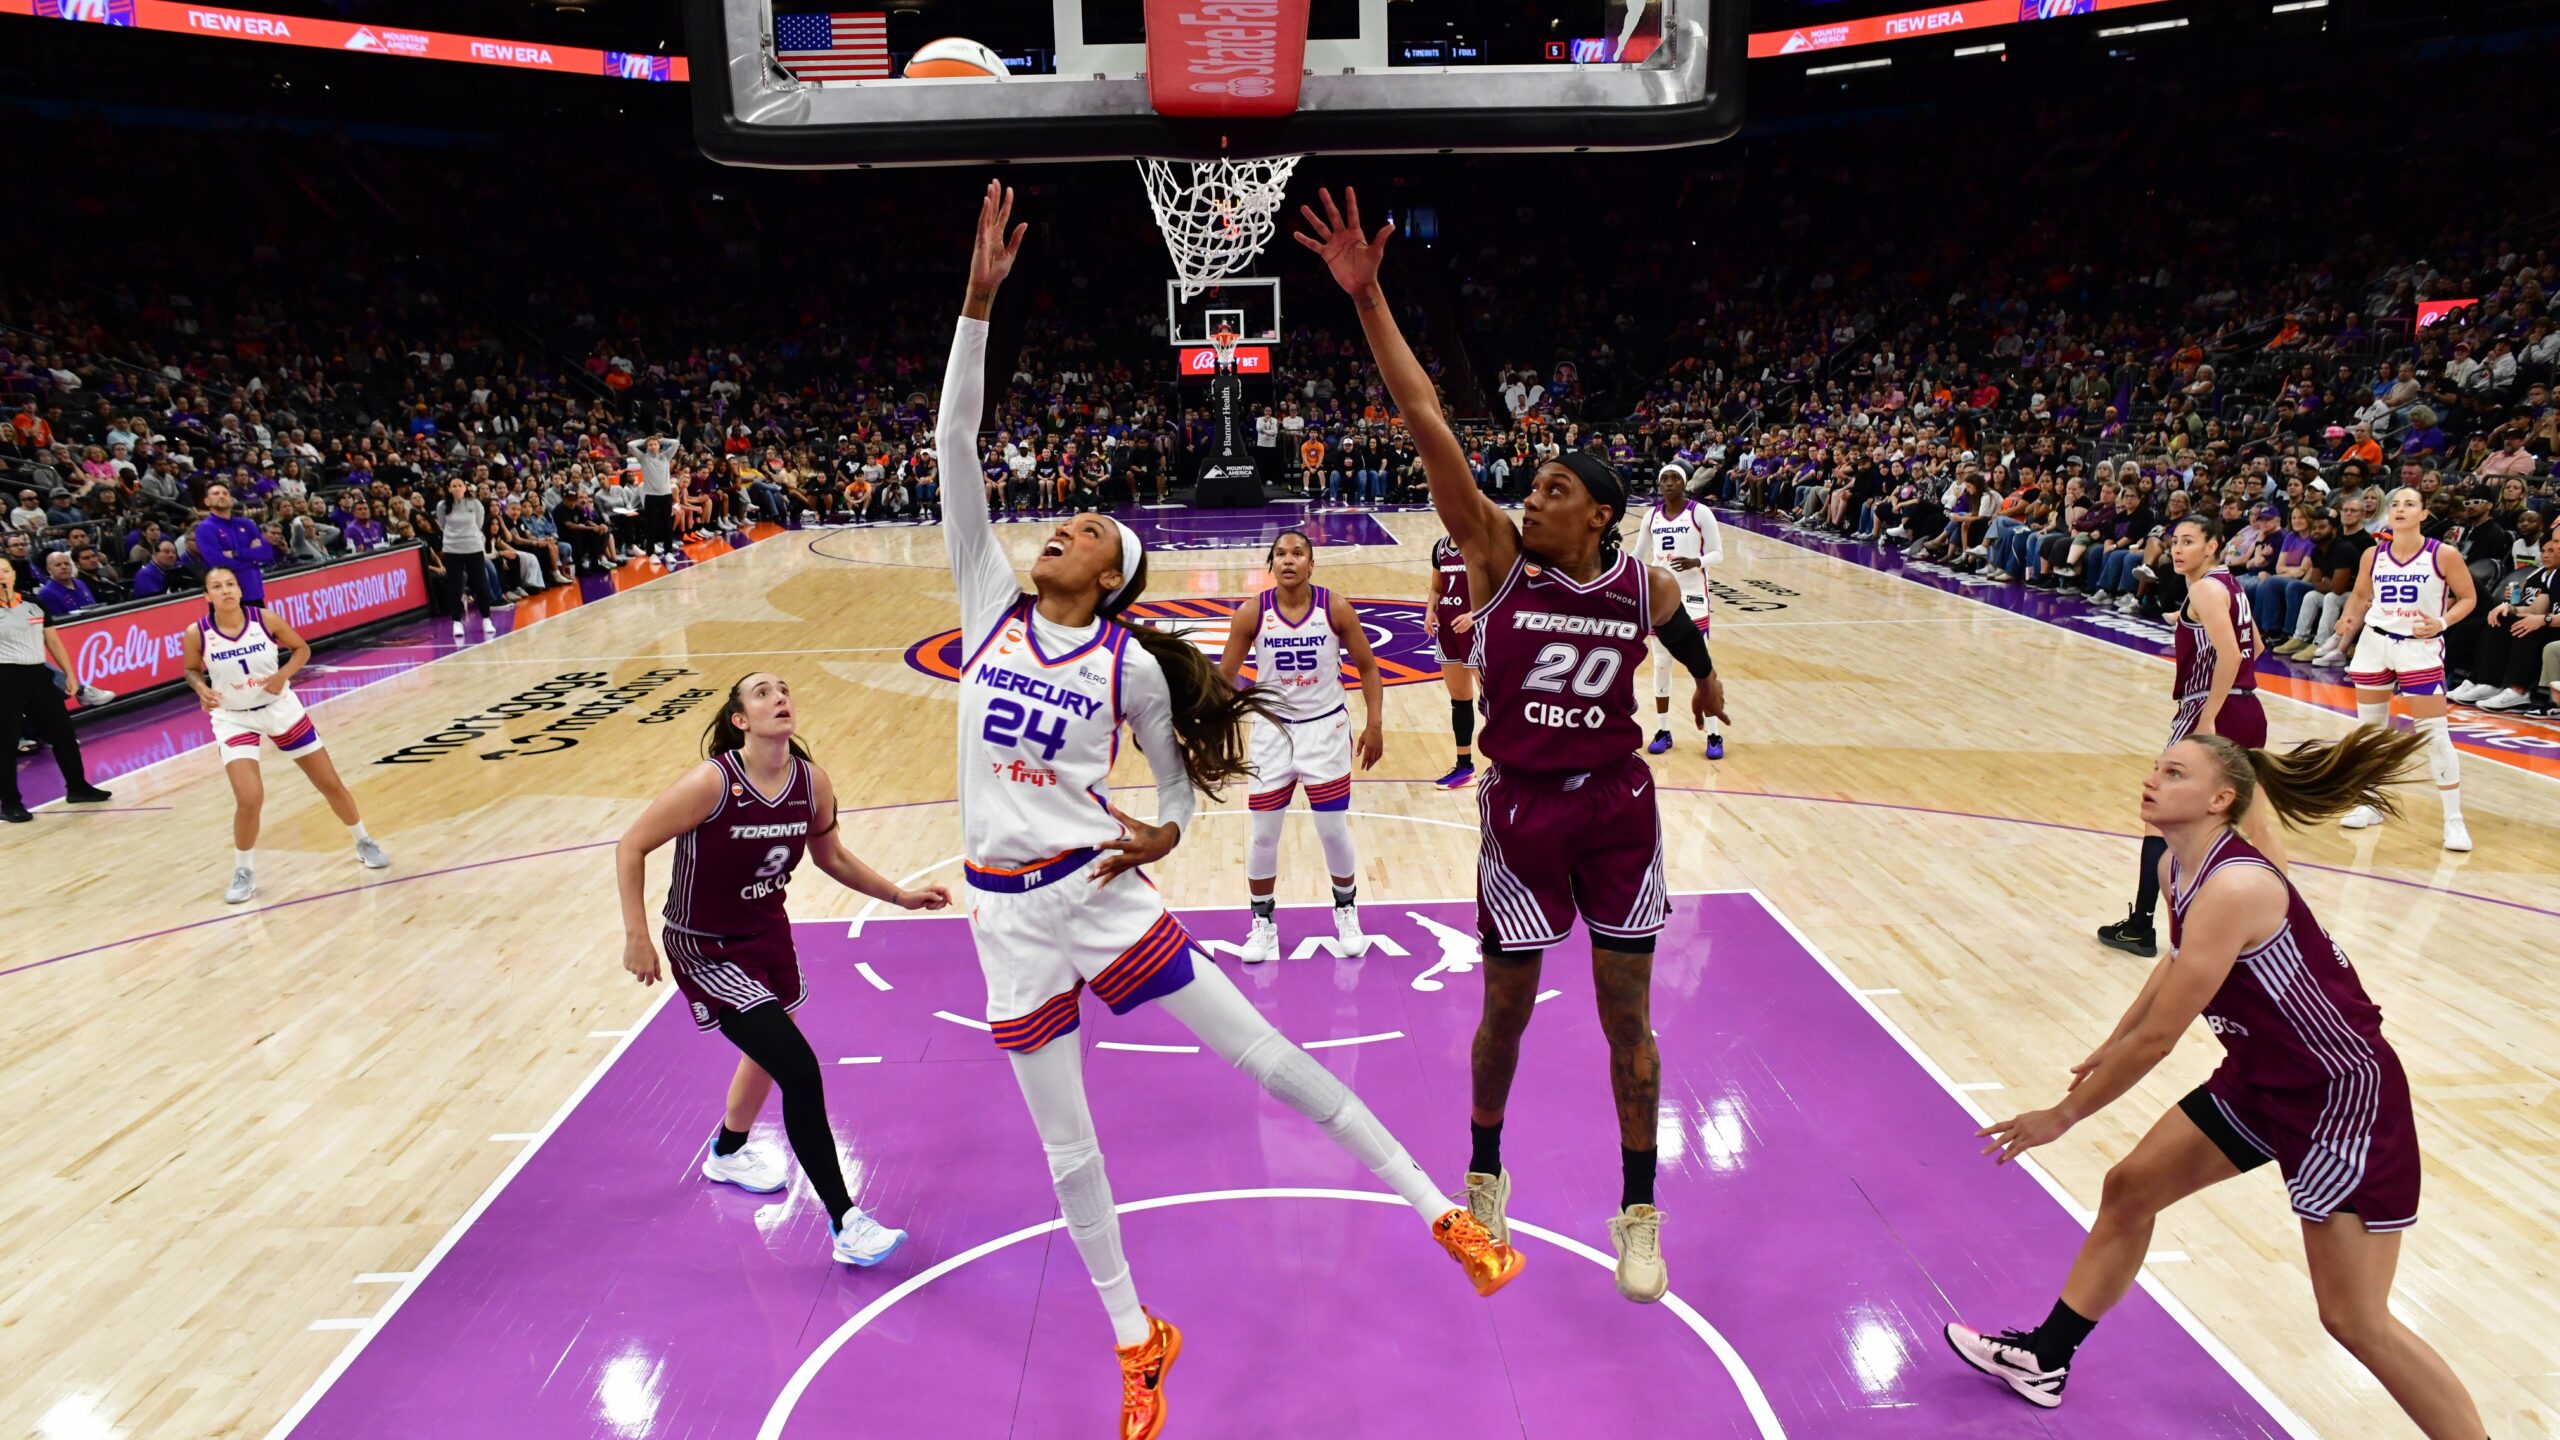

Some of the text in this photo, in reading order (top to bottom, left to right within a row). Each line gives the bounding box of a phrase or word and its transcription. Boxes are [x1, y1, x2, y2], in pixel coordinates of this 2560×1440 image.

[244, 17, 291, 37] ERA
[1927, 10, 1964, 27] ERA
[382, 32, 429, 44] MOUNTAIN
[1810, 26, 1849, 39] MOUNTAIN
[1812, 34, 1846, 45] AMERICA
[386, 40, 427, 52] AMERICA
[1404, 48, 1439, 58] 4 TIMEOUTS
[1458, 48, 1476, 57] FOULS
[1551, 46, 1558, 56] 5
[515, 48, 552, 64] ERA
[1026, 56, 1032, 67] 3
[1242, 357, 1259, 367] BET
[1221, 386, 1232, 447] Banner Health
[1652, 526, 1690, 535] MERCURY
[1661, 535, 1675, 551] 2
[1447, 575, 1456, 594] 7
[2374, 574, 2430, 584] MERCURY
[285, 591, 313, 629] THE
[312, 573, 387, 622] SPORTSBOOK
[386, 567, 408, 599] APP
[1605, 591, 1637, 607] SEPHORA
[2380, 585, 2418, 603] 29
[2235, 591, 2252, 626] 10
[1512, 610, 1638, 640] TORONTO
[1263, 635, 1328, 648] MERCURY
[77, 624, 186, 686] Bally BE
[210, 642, 266, 662] MERCURY
[1274, 649, 1318, 671] 25
[237, 658, 250, 676] 1
[1520, 642, 1622, 698] 20
[541, 668, 699, 732] matchup
[975, 663, 1103, 721] MERCURY
[637, 688, 719, 724] center
[1524, 702, 1583, 728] CIBC
[372, 671, 608, 765] mortgage
[982, 697, 1068, 762] 24
[1006, 759, 1057, 787] fry's
[729, 821, 808, 839] TORONTO
[754, 845, 791, 877] 3
[740, 877, 774, 900] CIBC
[2207, 1015, 2237, 1034] BC
